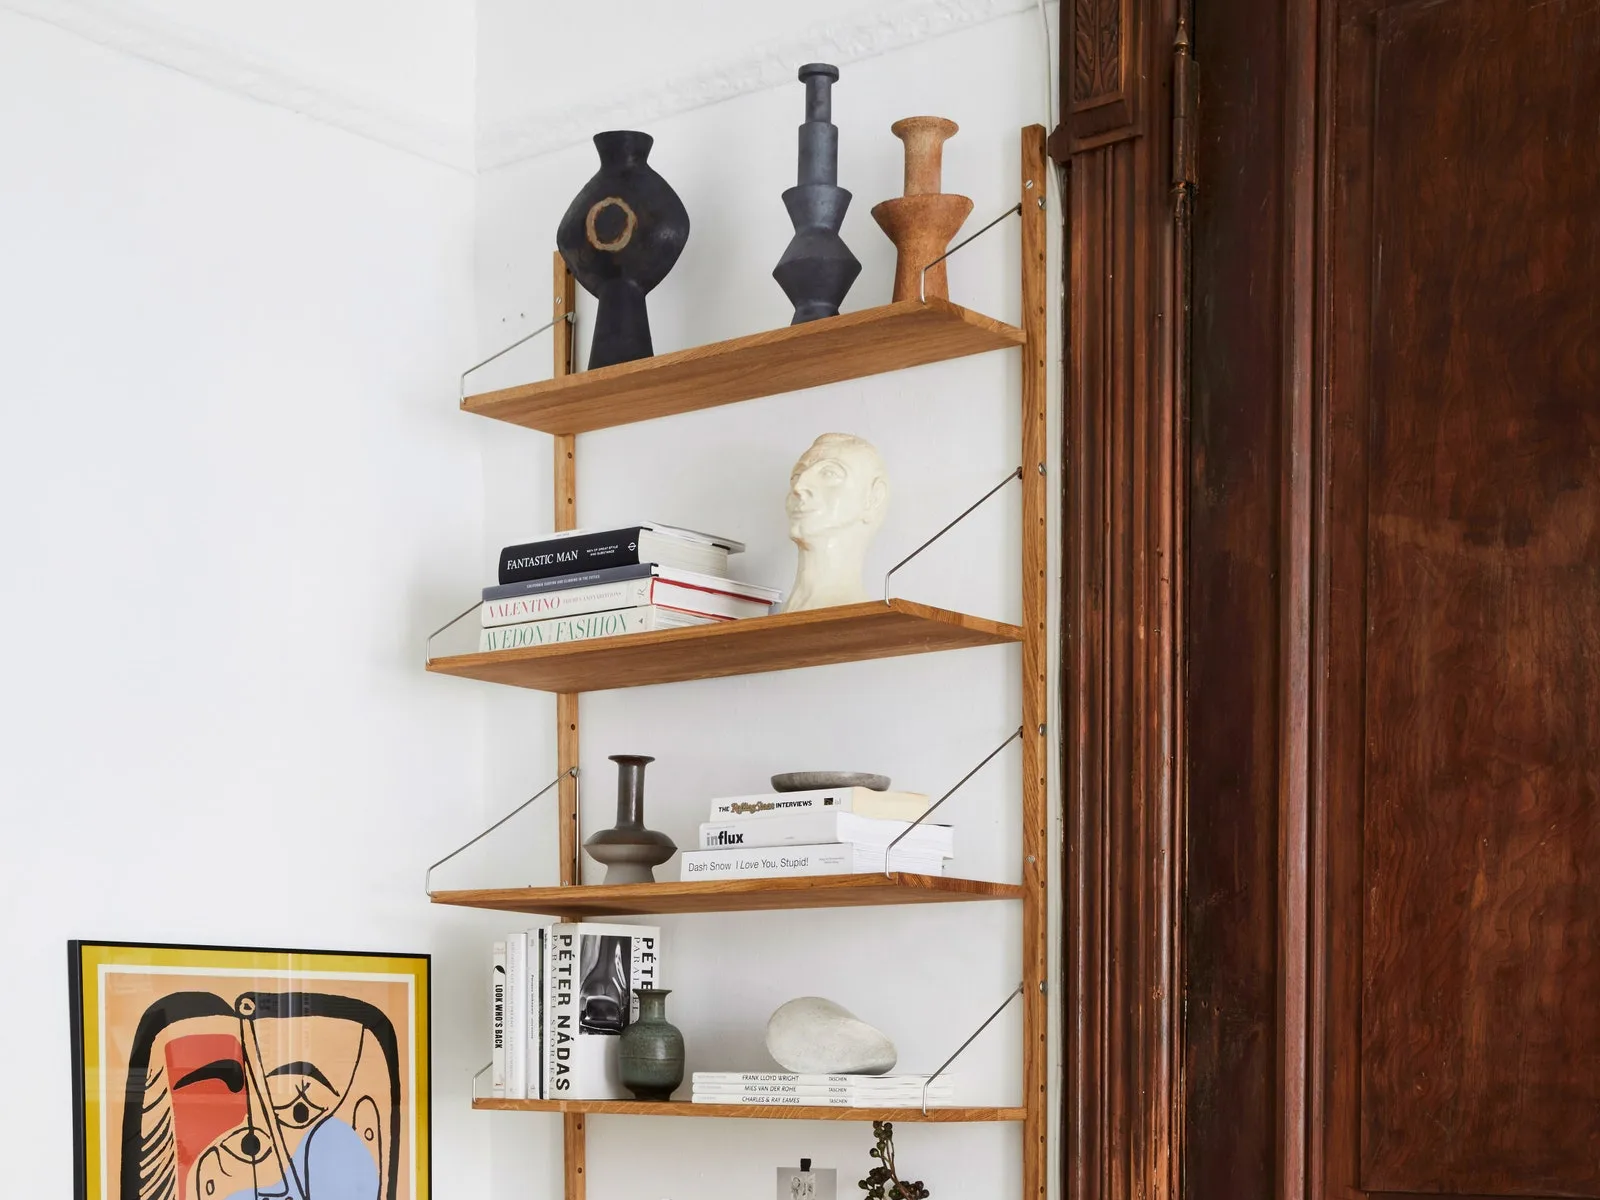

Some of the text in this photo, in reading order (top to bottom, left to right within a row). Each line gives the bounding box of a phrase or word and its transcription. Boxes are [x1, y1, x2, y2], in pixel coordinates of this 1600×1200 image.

[506, 549, 579, 570] FANTASTIC MAN
[488, 596, 560, 618] VALENTINO
[485, 613, 628, 651] AVEDON FASHION
[775, 800, 813, 809] INTERVIEWS
[706, 830, 744, 846] influx
[688, 861, 708, 872] Dash
[709, 860, 732, 871] Snow
[739, 859, 759, 870] Love
[780, 857, 809, 870] Stupid!
[632, 937, 641, 1012] PARALEL
[641, 937, 657, 990] PÉTE
[495, 984, 503, 1049] LOOK WHO'S BACK
[556, 934, 576, 1091] PÉTER NÁDAS
